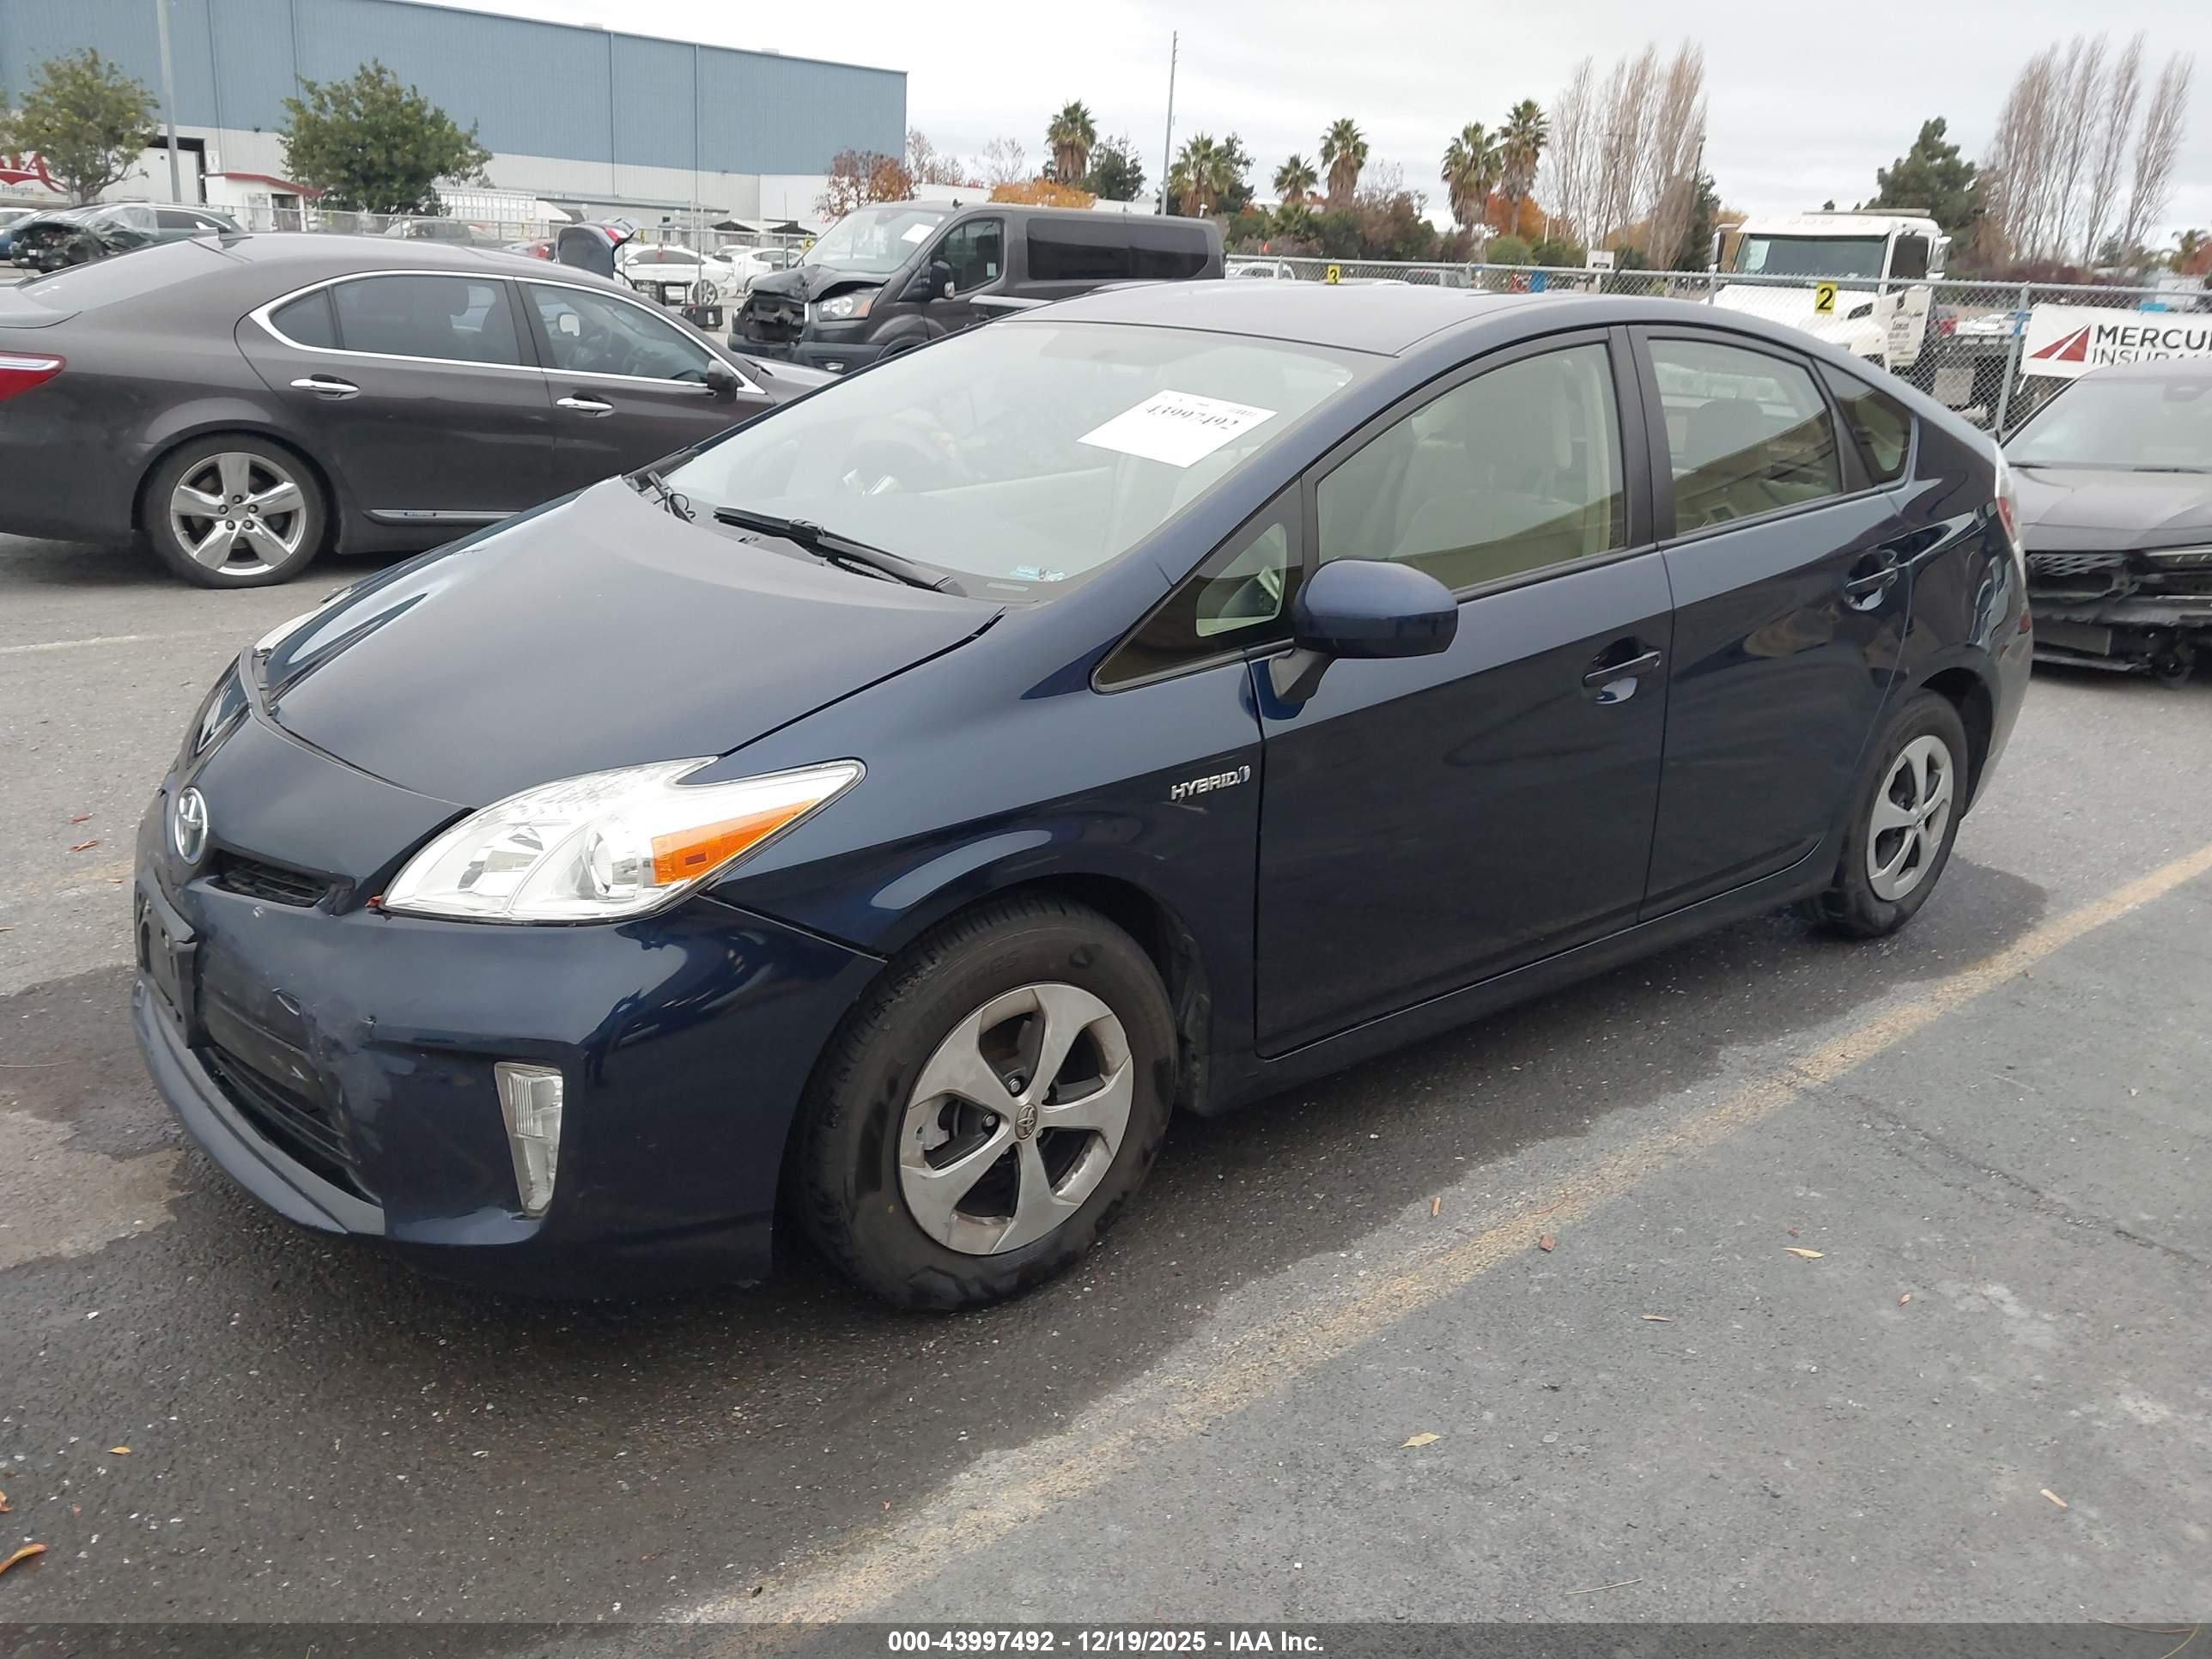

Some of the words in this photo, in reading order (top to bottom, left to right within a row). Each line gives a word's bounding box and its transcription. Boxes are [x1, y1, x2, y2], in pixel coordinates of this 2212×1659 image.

[1817, 287, 1832, 310] 2
[2095, 325, 2212, 350] MERCU
[1170, 771, 1238, 800] HYBRID
